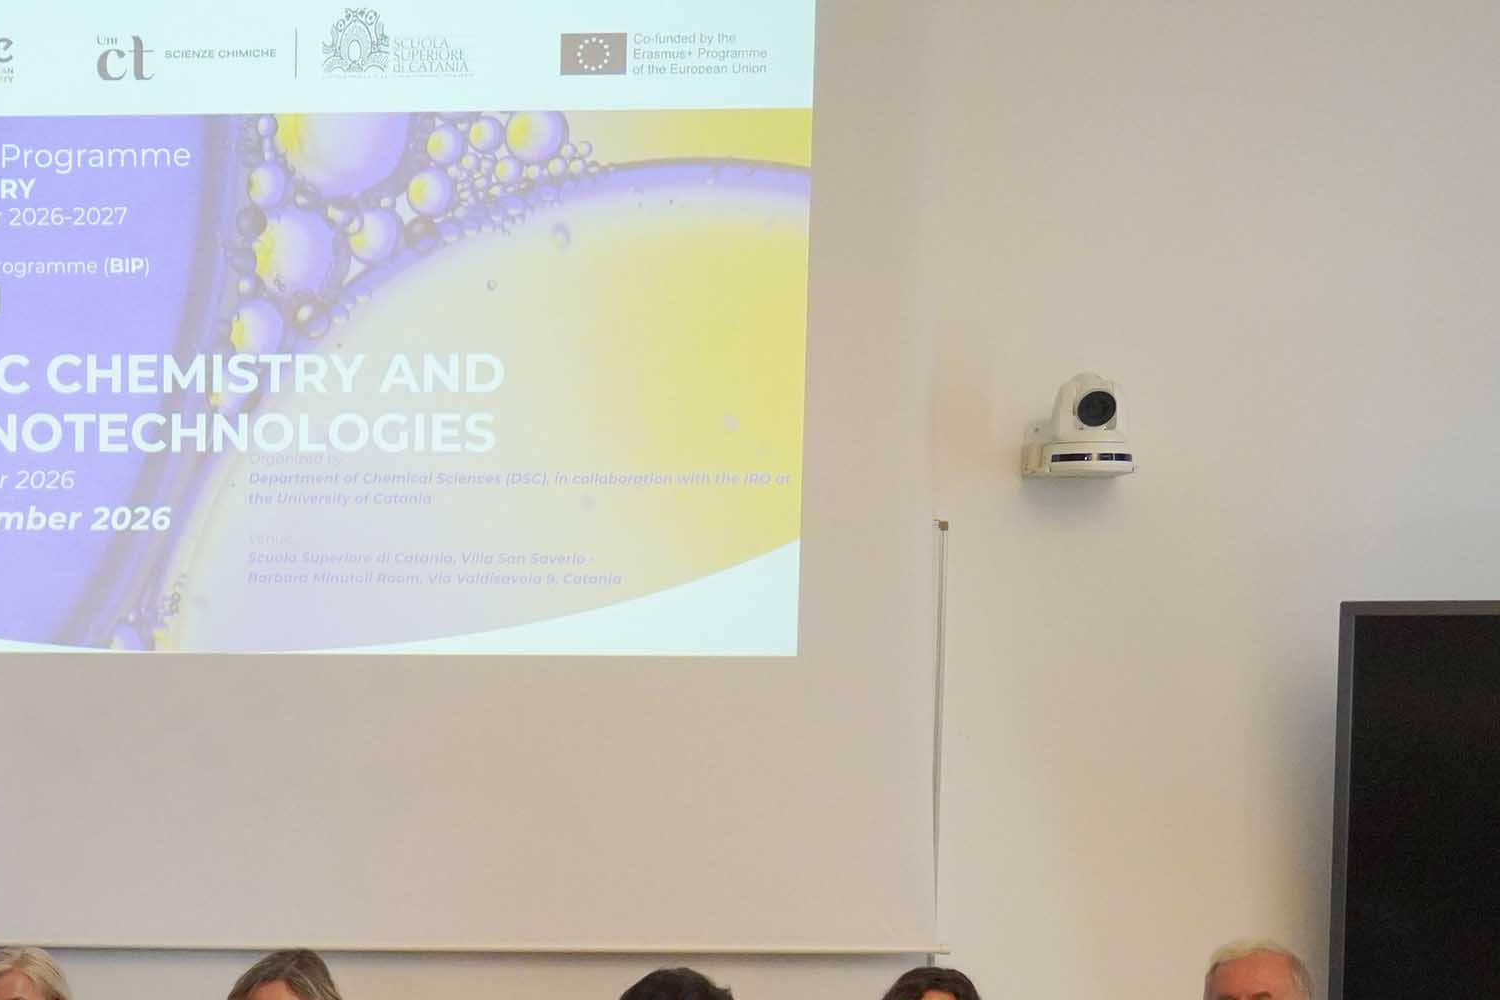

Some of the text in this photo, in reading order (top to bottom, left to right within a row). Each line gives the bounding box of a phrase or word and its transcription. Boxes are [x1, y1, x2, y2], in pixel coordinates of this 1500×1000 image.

[632, 31, 736, 46] Co-funded by the
[164, 48, 276, 59] SCIENZE CHIMICHE
[632, 47, 767, 61] Erasmus+ Programme
[632, 62, 766, 75] of the European Union
[2, 142, 192, 174] Programme
[9, 206, 127, 226] 2026-2027
[104, 257, 149, 276] (BIP)
[46, 352, 365, 396] CHEMISTRY
[379, 352, 504, 392] AND
[14, 470, 75, 489] 2026
[90, 506, 171, 530] 2026
